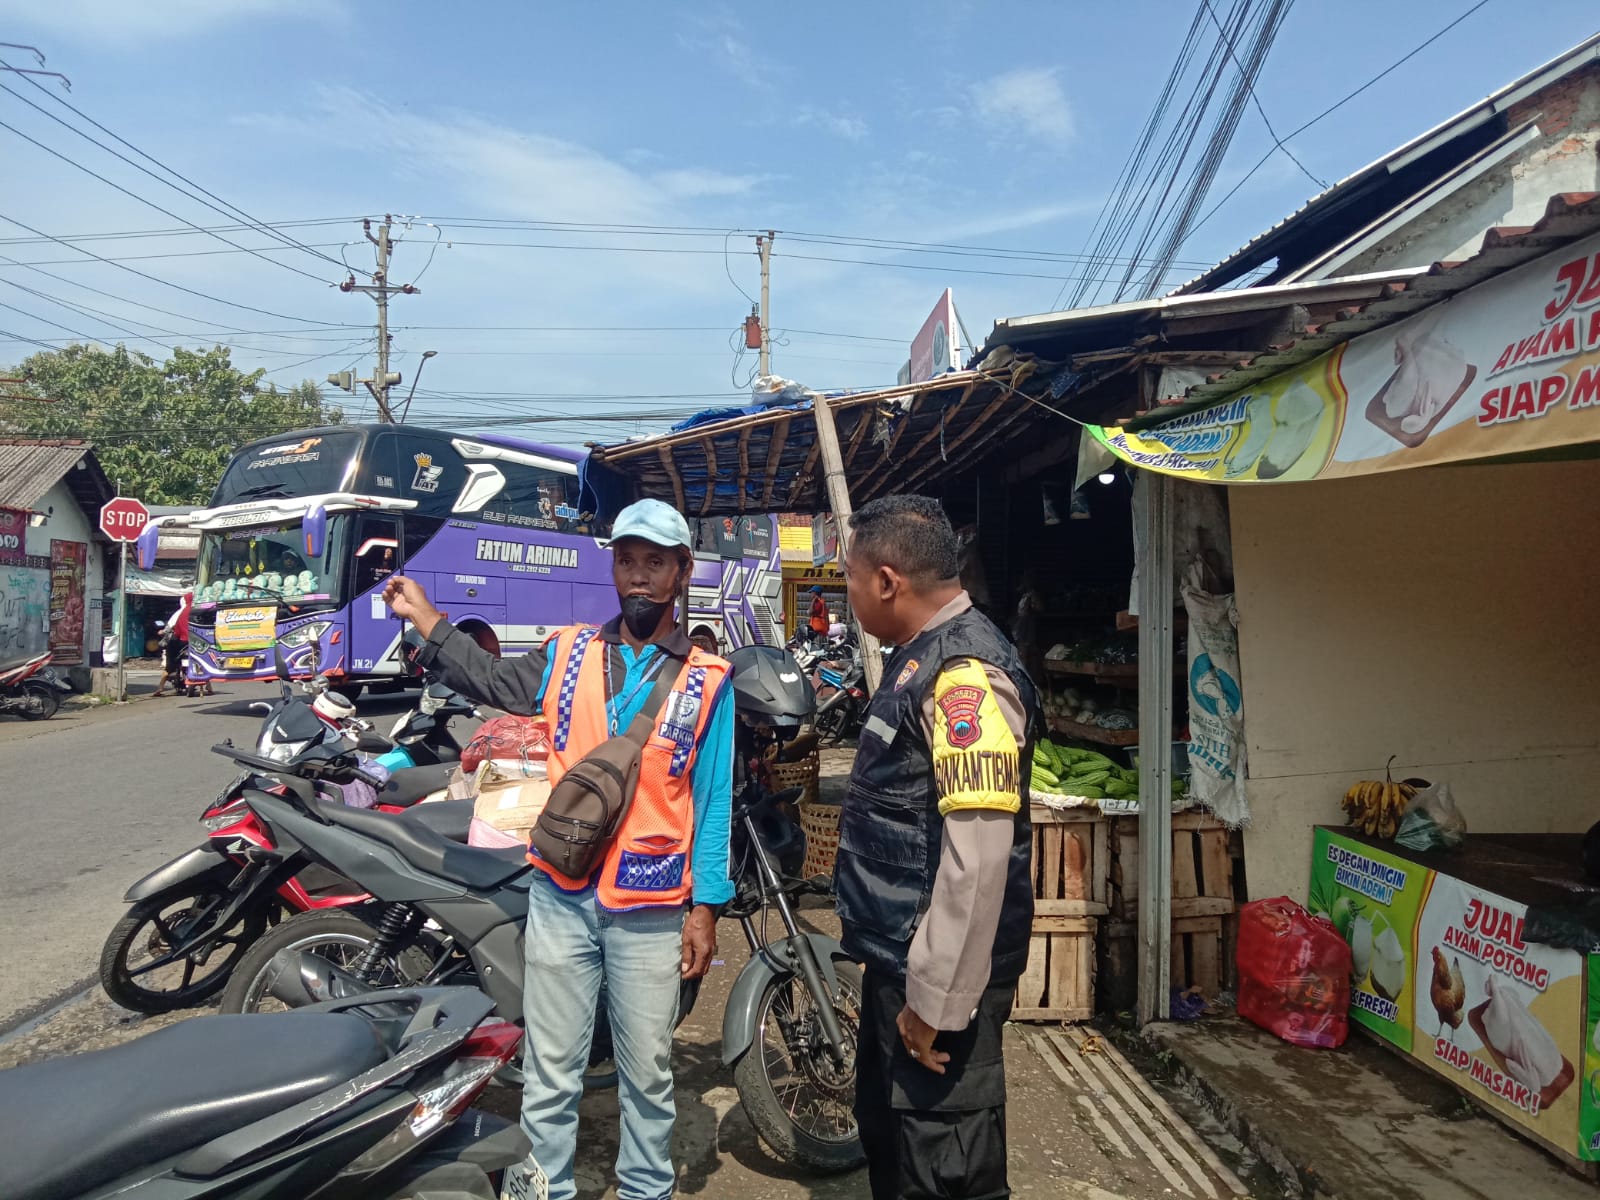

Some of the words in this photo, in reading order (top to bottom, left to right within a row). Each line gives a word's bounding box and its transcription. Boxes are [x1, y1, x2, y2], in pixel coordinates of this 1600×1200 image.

[1490, 317, 1576, 374] AYAM
[1478, 374, 1566, 423] SIAP
[106, 510, 146, 528] STOP
[476, 539, 523, 563] FATUM
[525, 545, 578, 568] ARIINAA
[660, 723, 694, 747] PARKIR
[1328, 845, 1338, 861] ES
[1339, 849, 1370, 874] DEGAN
[1370, 860, 1405, 889] DINGIN
[1335, 867, 1361, 889] BIKIN
[1360, 878, 1387, 902] ADEM
[1463, 898, 1526, 951] JUAL
[1443, 926, 1480, 958] AYAM
[1481, 943, 1548, 988] POTONG
[1359, 991, 1393, 1018] FRESH
[1434, 1038, 1470, 1068] SIAP
[1470, 1058, 1529, 1108] MASAK
